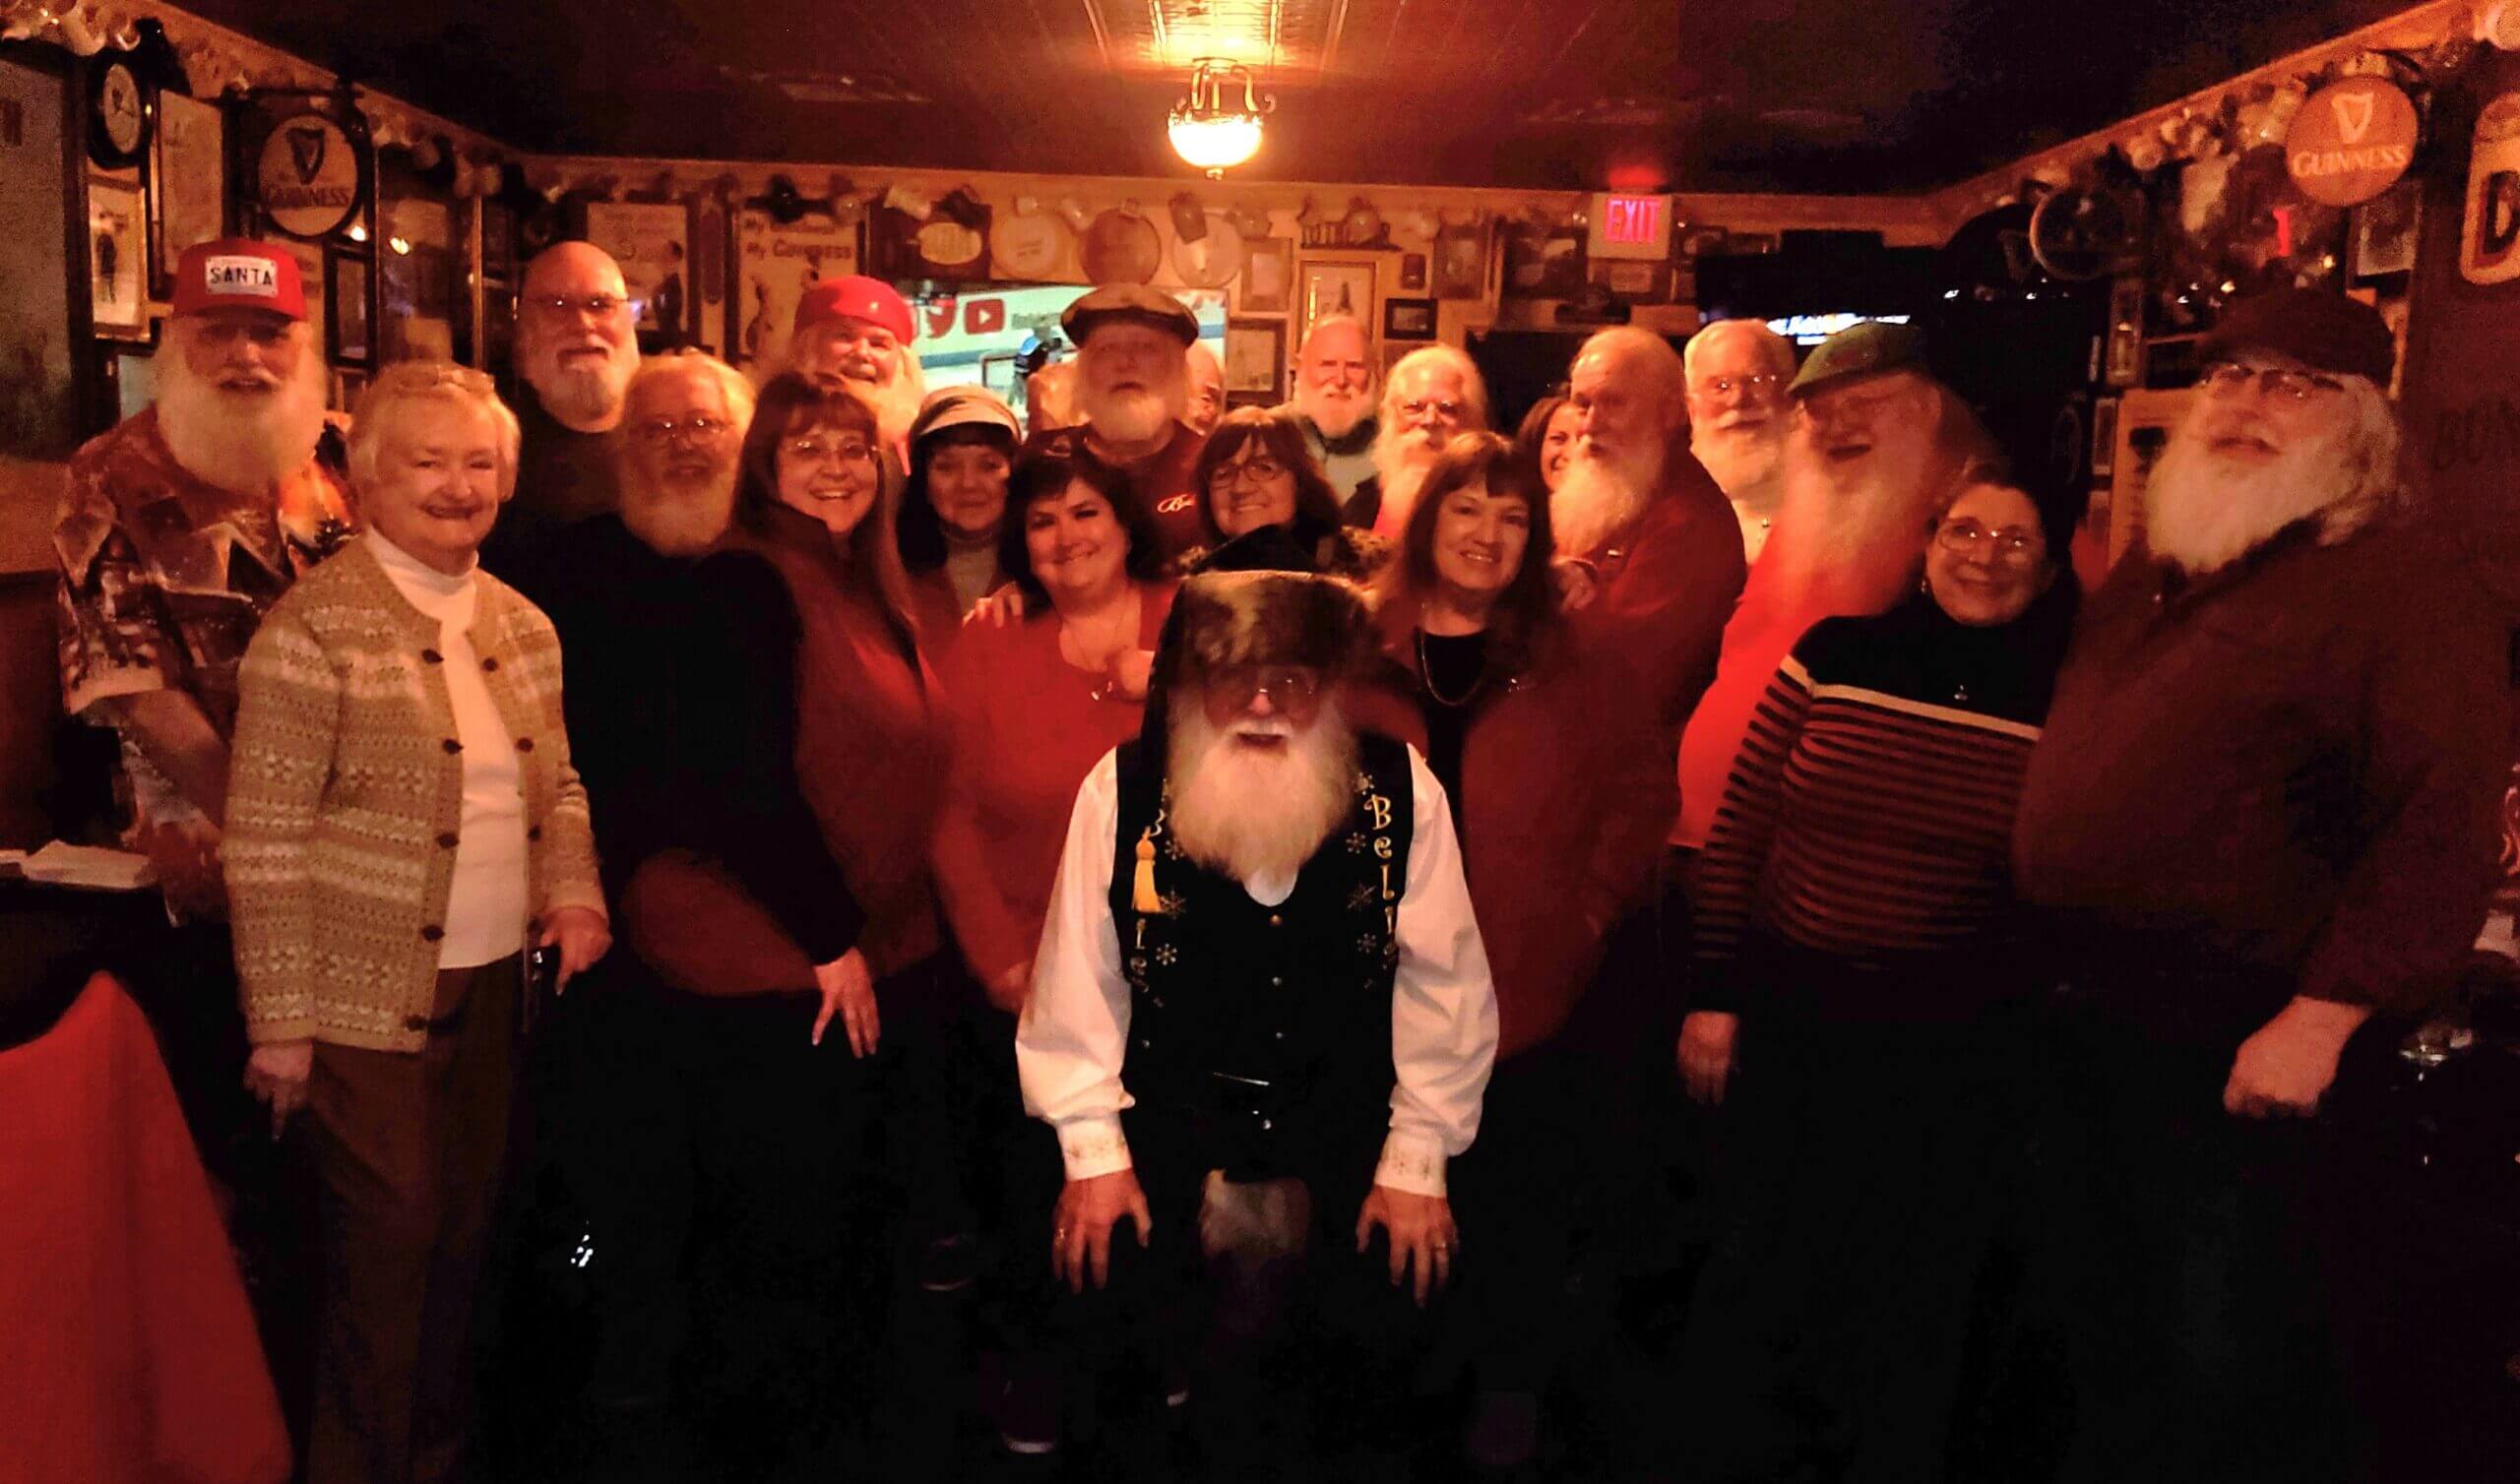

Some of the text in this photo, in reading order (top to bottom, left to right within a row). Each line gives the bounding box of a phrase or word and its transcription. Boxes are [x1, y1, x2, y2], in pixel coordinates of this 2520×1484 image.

[2292, 145, 2407, 178] GUINNESS
[261, 185, 350, 209] GUINNESS
[1606, 199, 1660, 242] EXIT
[210, 266, 273, 285] SANTA
